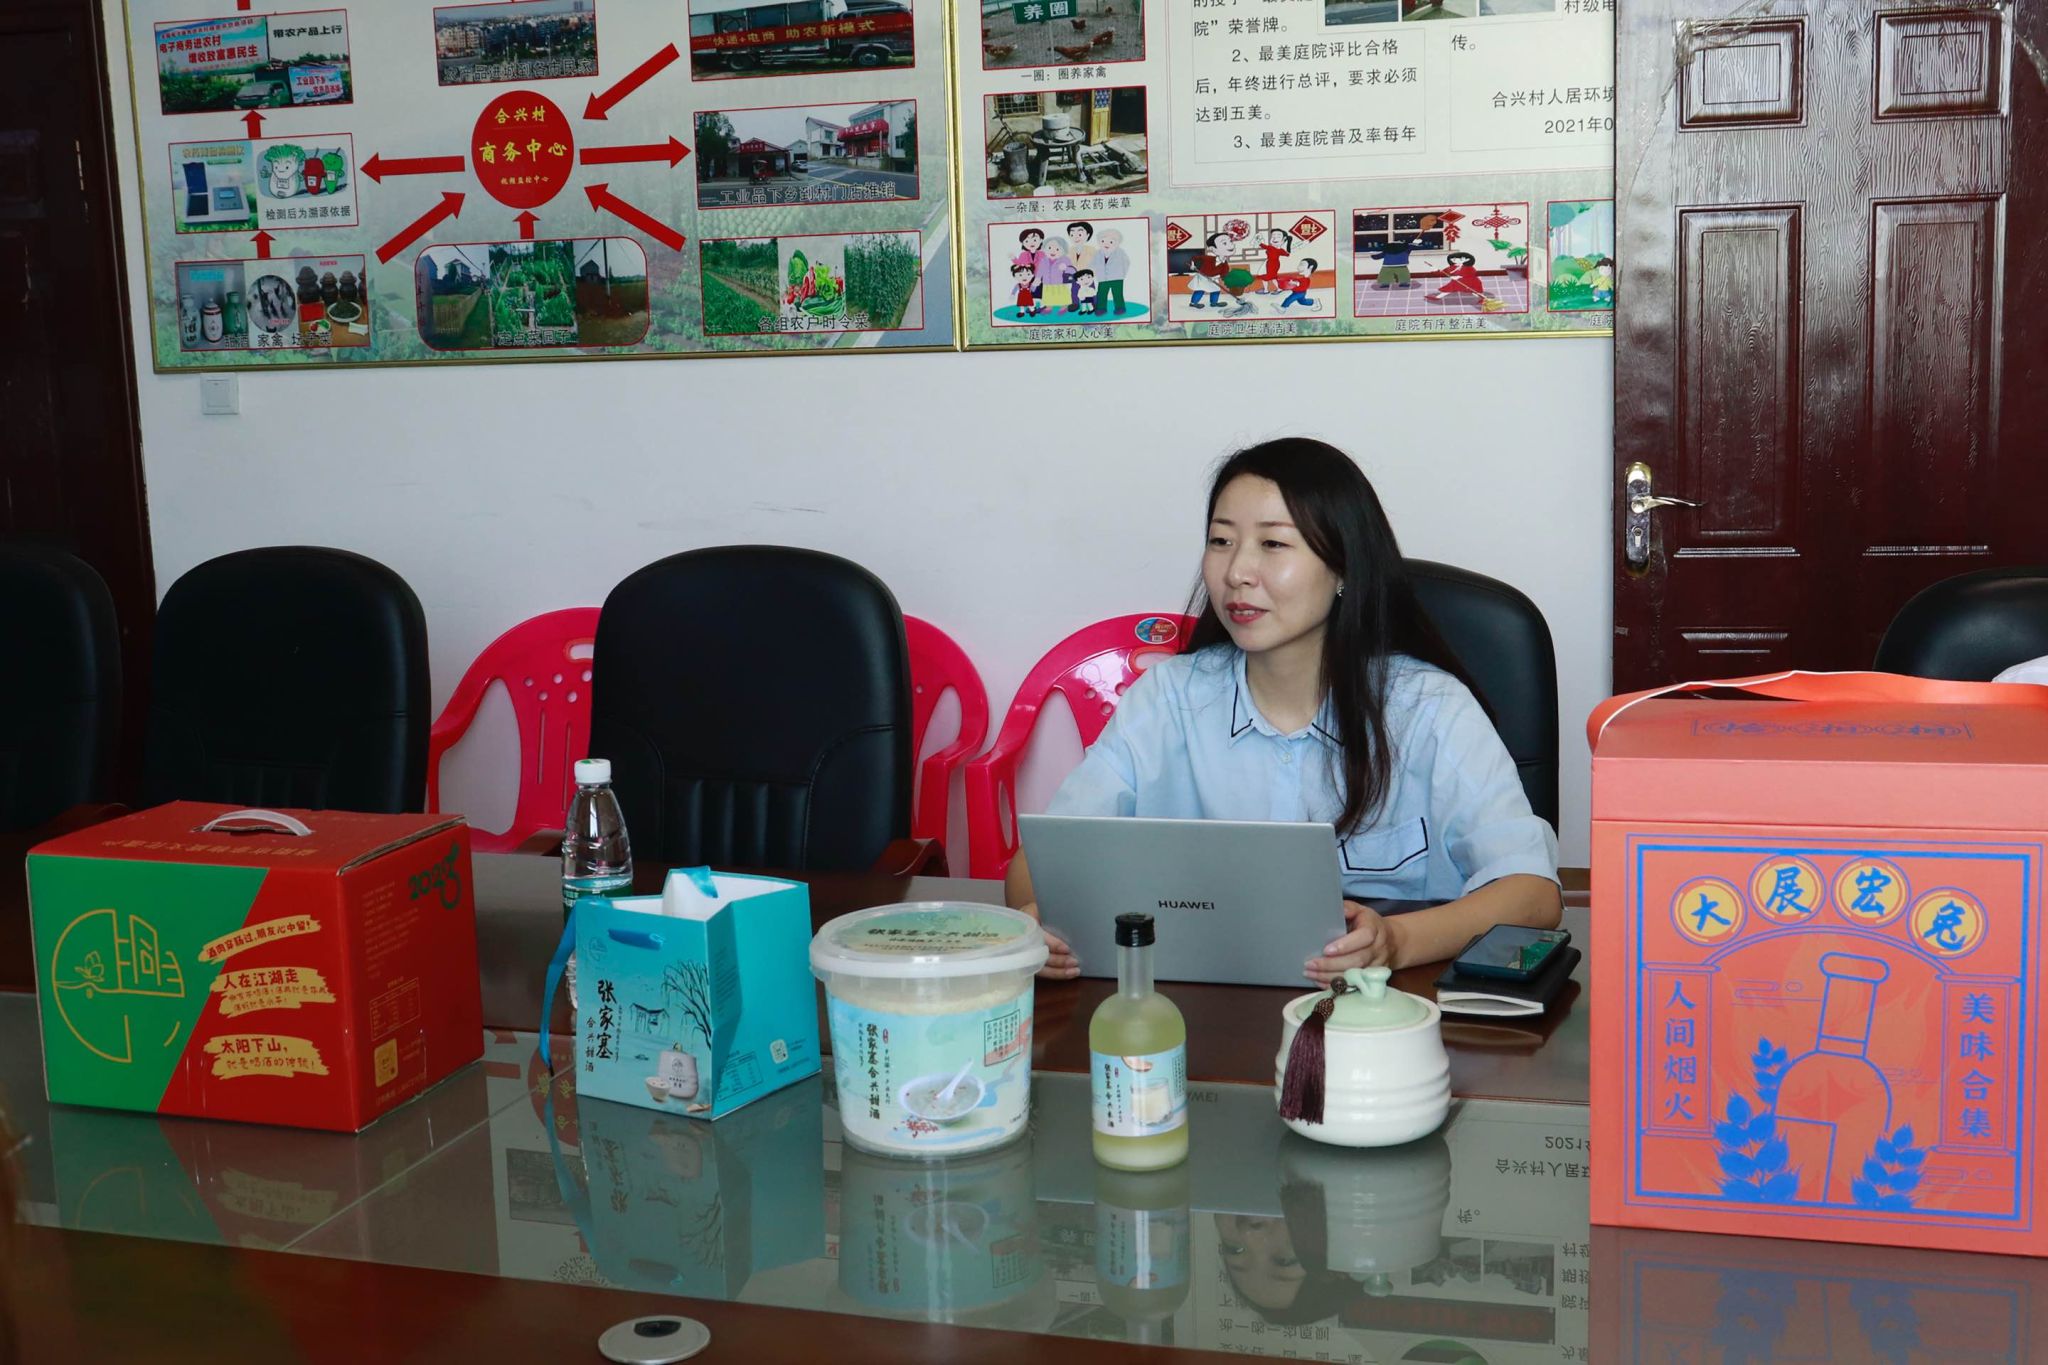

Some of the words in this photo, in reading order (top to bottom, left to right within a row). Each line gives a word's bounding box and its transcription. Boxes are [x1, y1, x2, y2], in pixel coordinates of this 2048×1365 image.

[273, 24, 343, 38] 带农产品上行
[786, 20, 875, 39] 助农新模式
[160, 34, 222, 53] 电子商务进农村
[1232, 39, 1398, 63] 2、最美庭院评比合格
[188, 45, 258, 64] 增收致富惠民生
[1195, 67, 1418, 94] 后，年终进行总评，要求必须
[494, 105, 546, 124] 合兴村
[1195, 105, 1271, 123] 达到五美。
[1233, 125, 1417, 149] 3、最美庭院普及率每年
[479, 138, 568, 164] 商务中心
[719, 181, 896, 205] 工业品下乡到村门店推销
[265, 205, 351, 221] 检测后为溯源依据
[1080, 198, 1104, 211] 农药
[1107, 197, 1132, 210] 柴草
[759, 312, 869, 332] 各组农户时令菜
[1208, 322, 1297, 336] 庭院卫生清洁美
[1395, 317, 1487, 331] 庭院有序整洁美
[257, 332, 284, 347] 家禽
[1028, 327, 1114, 341] 庭院家和人心美
[1158, 900, 1215, 911] HUAWEI
[1690, 865, 1968, 952] 大展宏兔
[223, 968, 299, 990] 人在江湖走
[1663, 979, 1697, 1123] 人间烟火
[1958, 993, 1997, 1139] 美味合集
